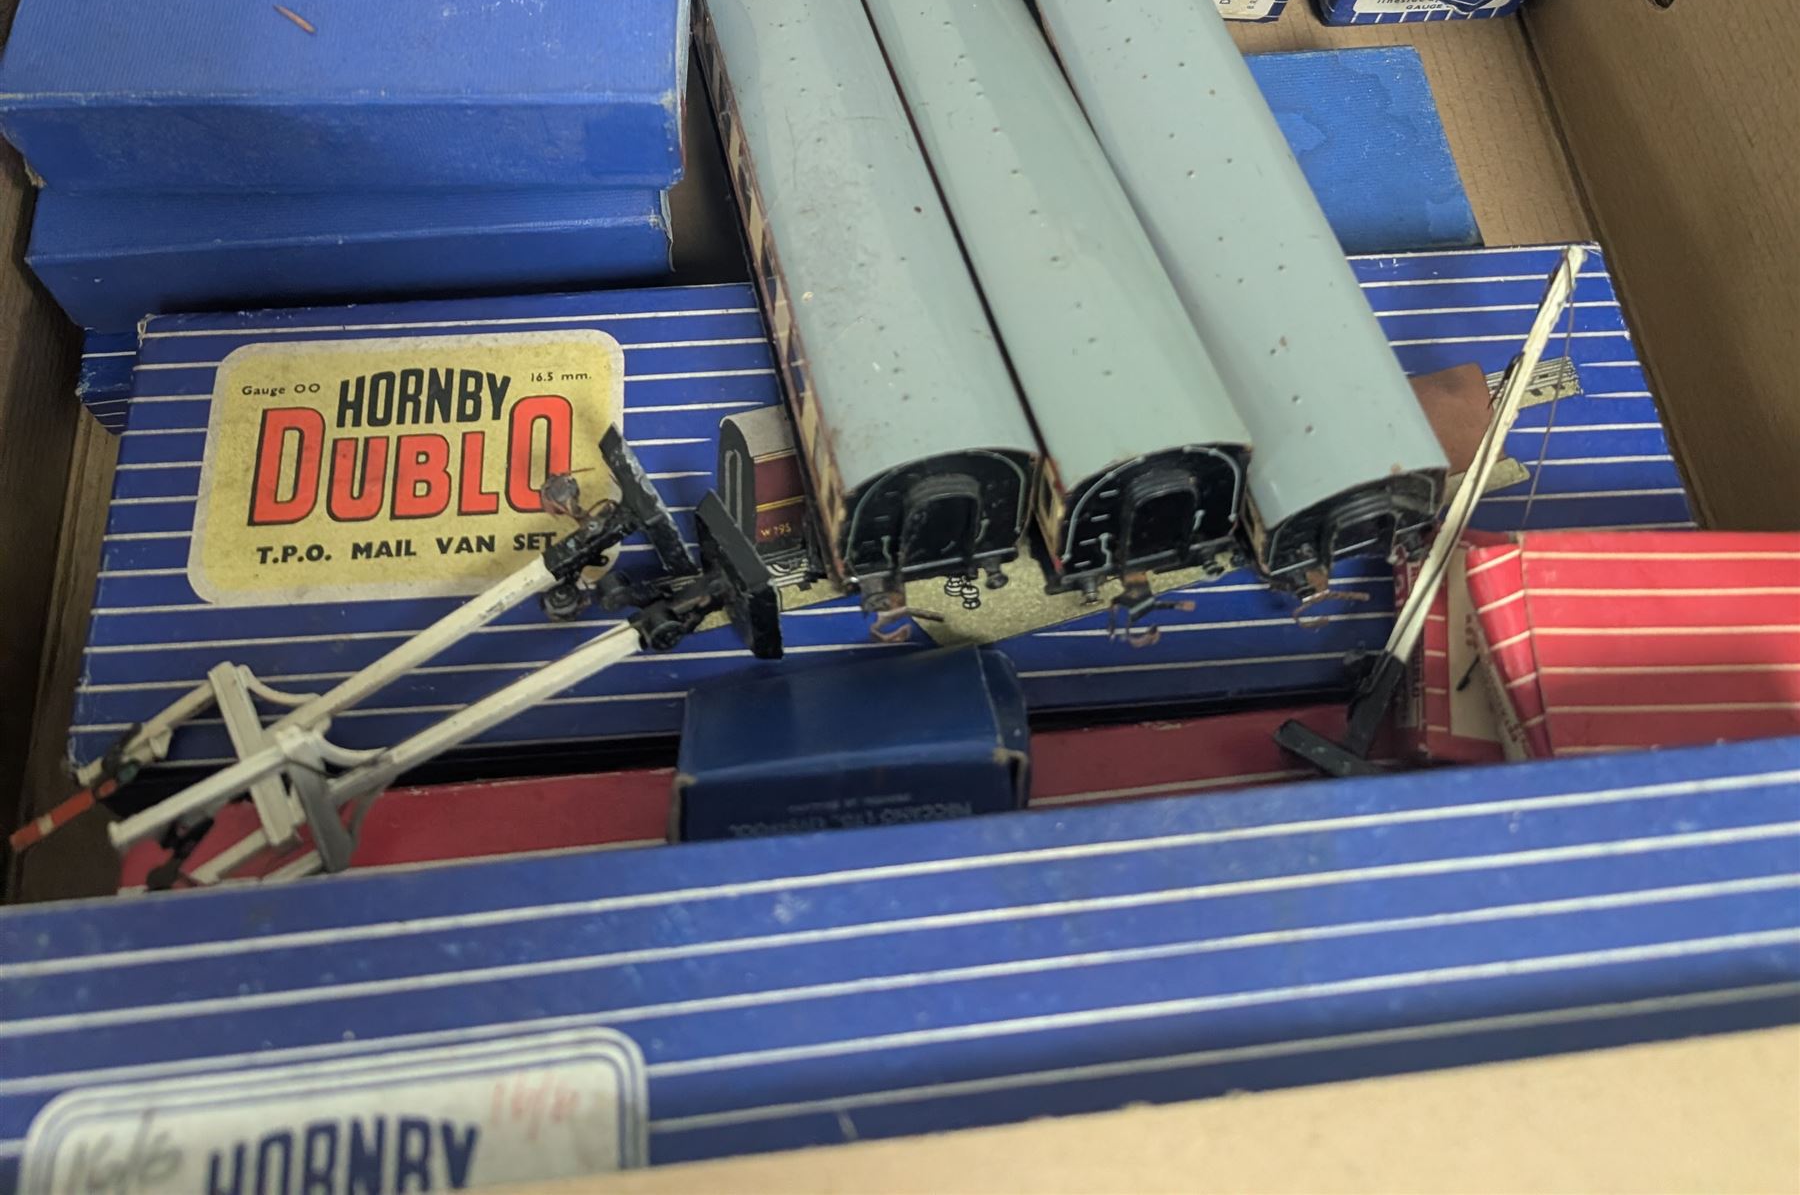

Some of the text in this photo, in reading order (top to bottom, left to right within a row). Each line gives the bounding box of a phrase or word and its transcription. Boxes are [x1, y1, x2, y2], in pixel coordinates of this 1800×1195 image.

[241, 384, 286, 397] Gauge
[530, 371, 593, 382] 16.5 mm.
[336, 367, 512, 428] HORNBY
[247, 394, 573, 526] DUBLO
[257, 531, 556, 564] T.P.O. MAIL VAN SET
